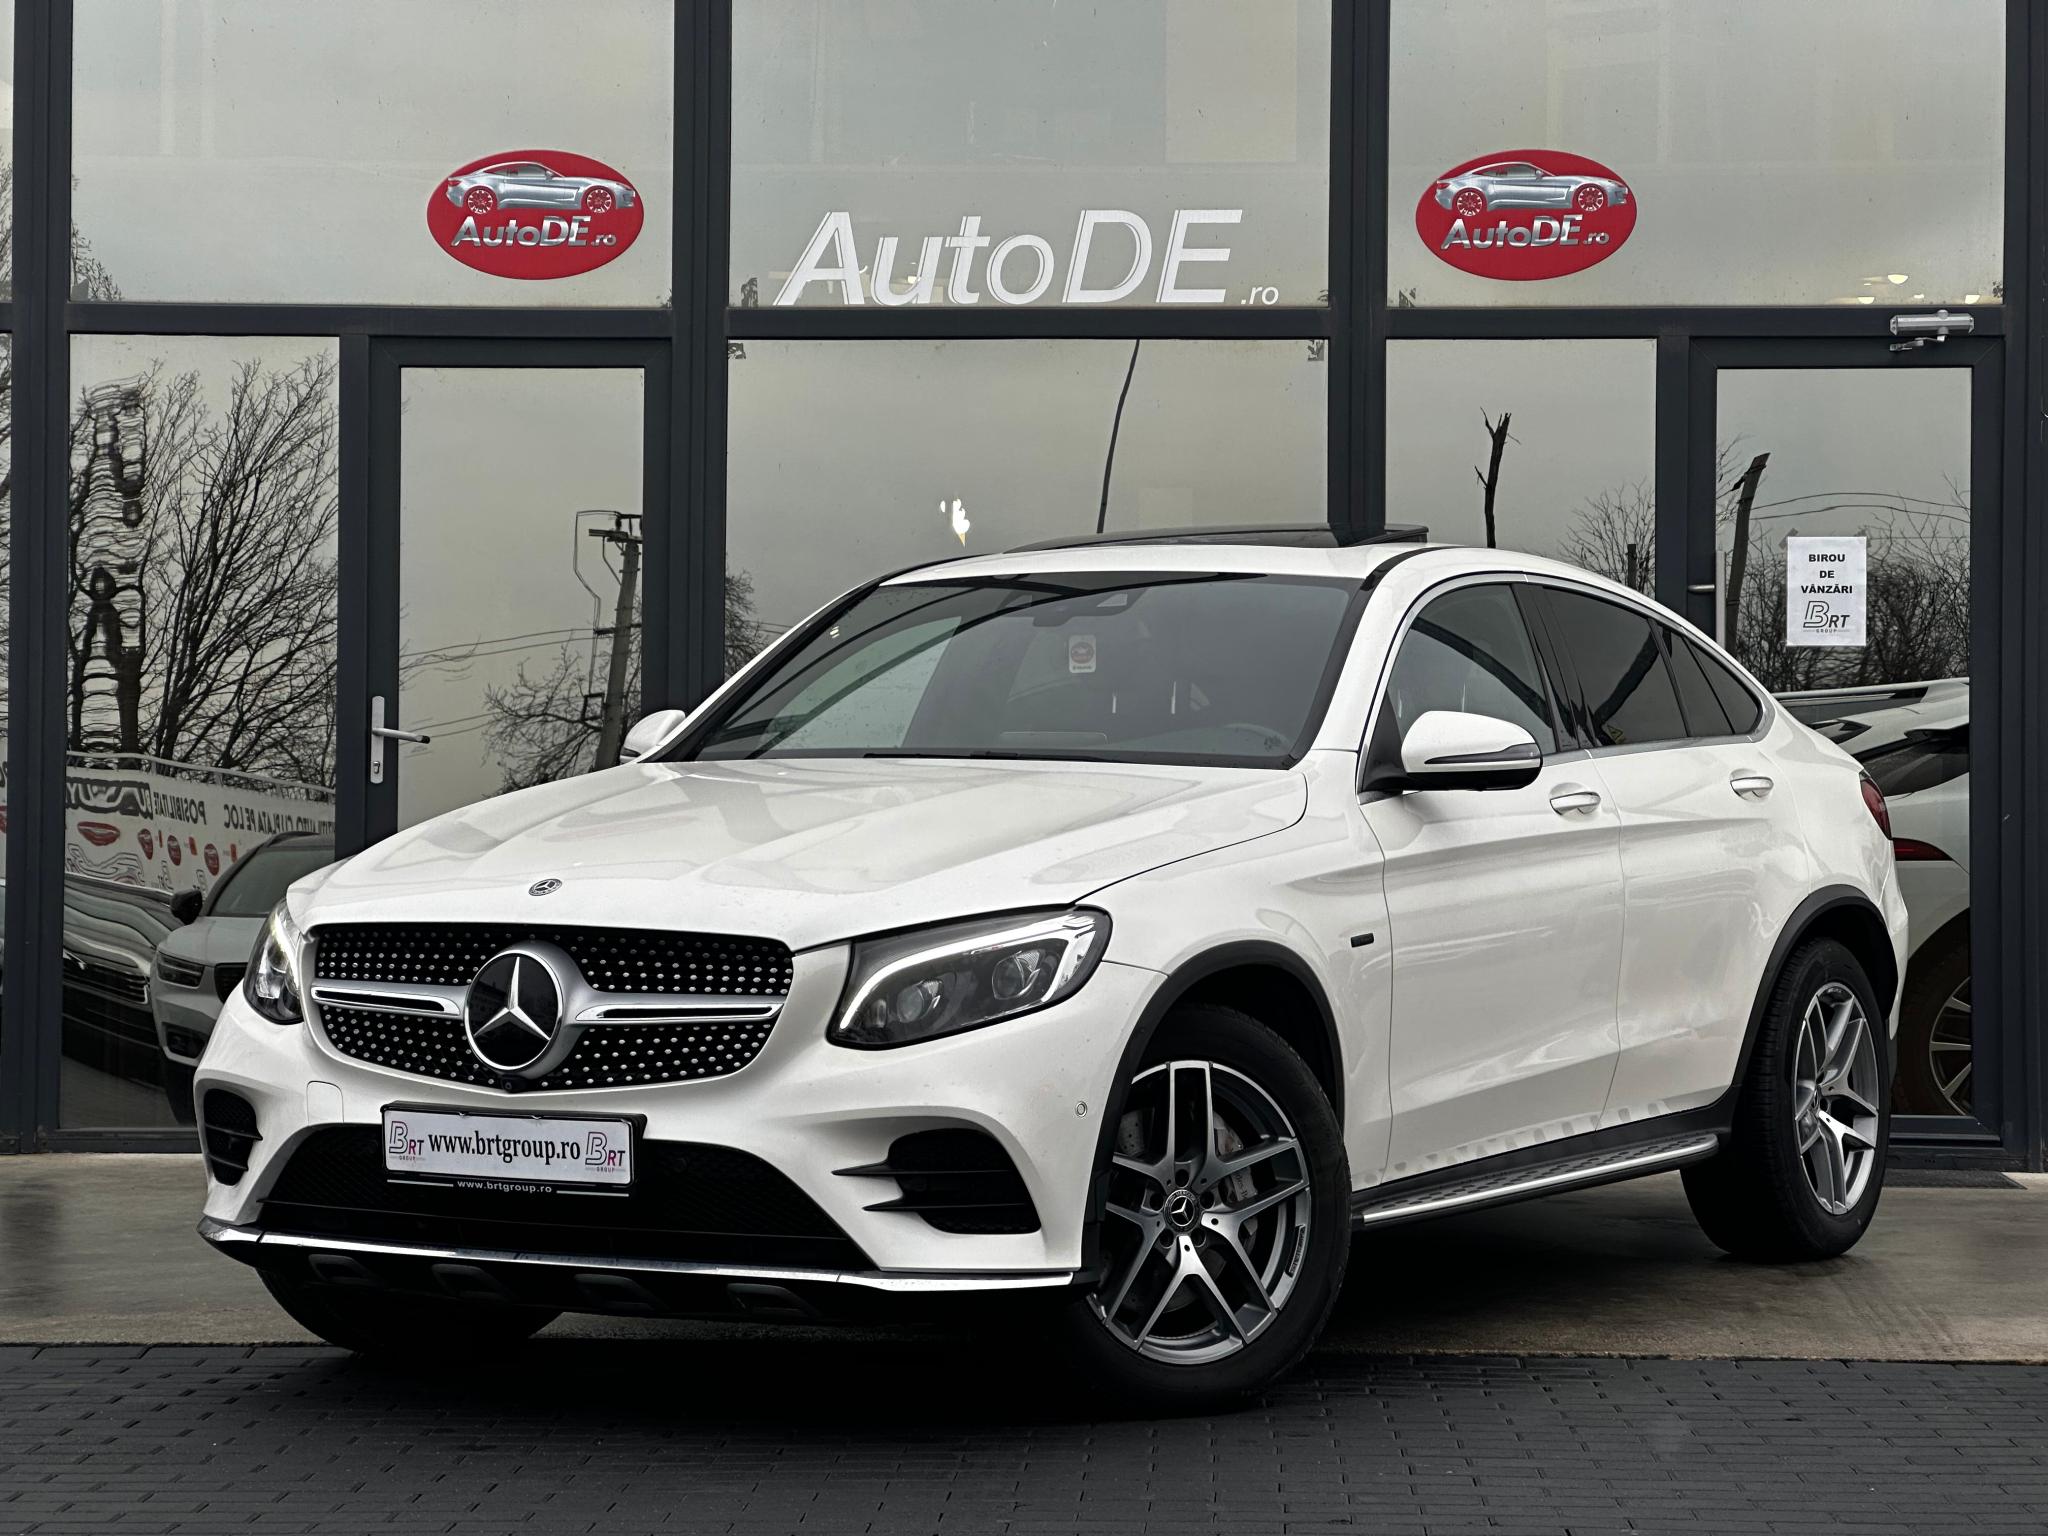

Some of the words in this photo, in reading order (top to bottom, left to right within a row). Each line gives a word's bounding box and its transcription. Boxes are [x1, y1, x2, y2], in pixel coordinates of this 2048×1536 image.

[1809, 554, 1845, 562] BIROU
[1819, 570, 1834, 578] DE
[1803, 600, 1850, 628] BRT
[388, 1120, 425, 1156] BRT
[428, 1130, 581, 1166] www.brtgroup.ro
[585, 1131, 626, 1165] BRT
[457, 1179, 552, 1194] www.brtgroup.ro
